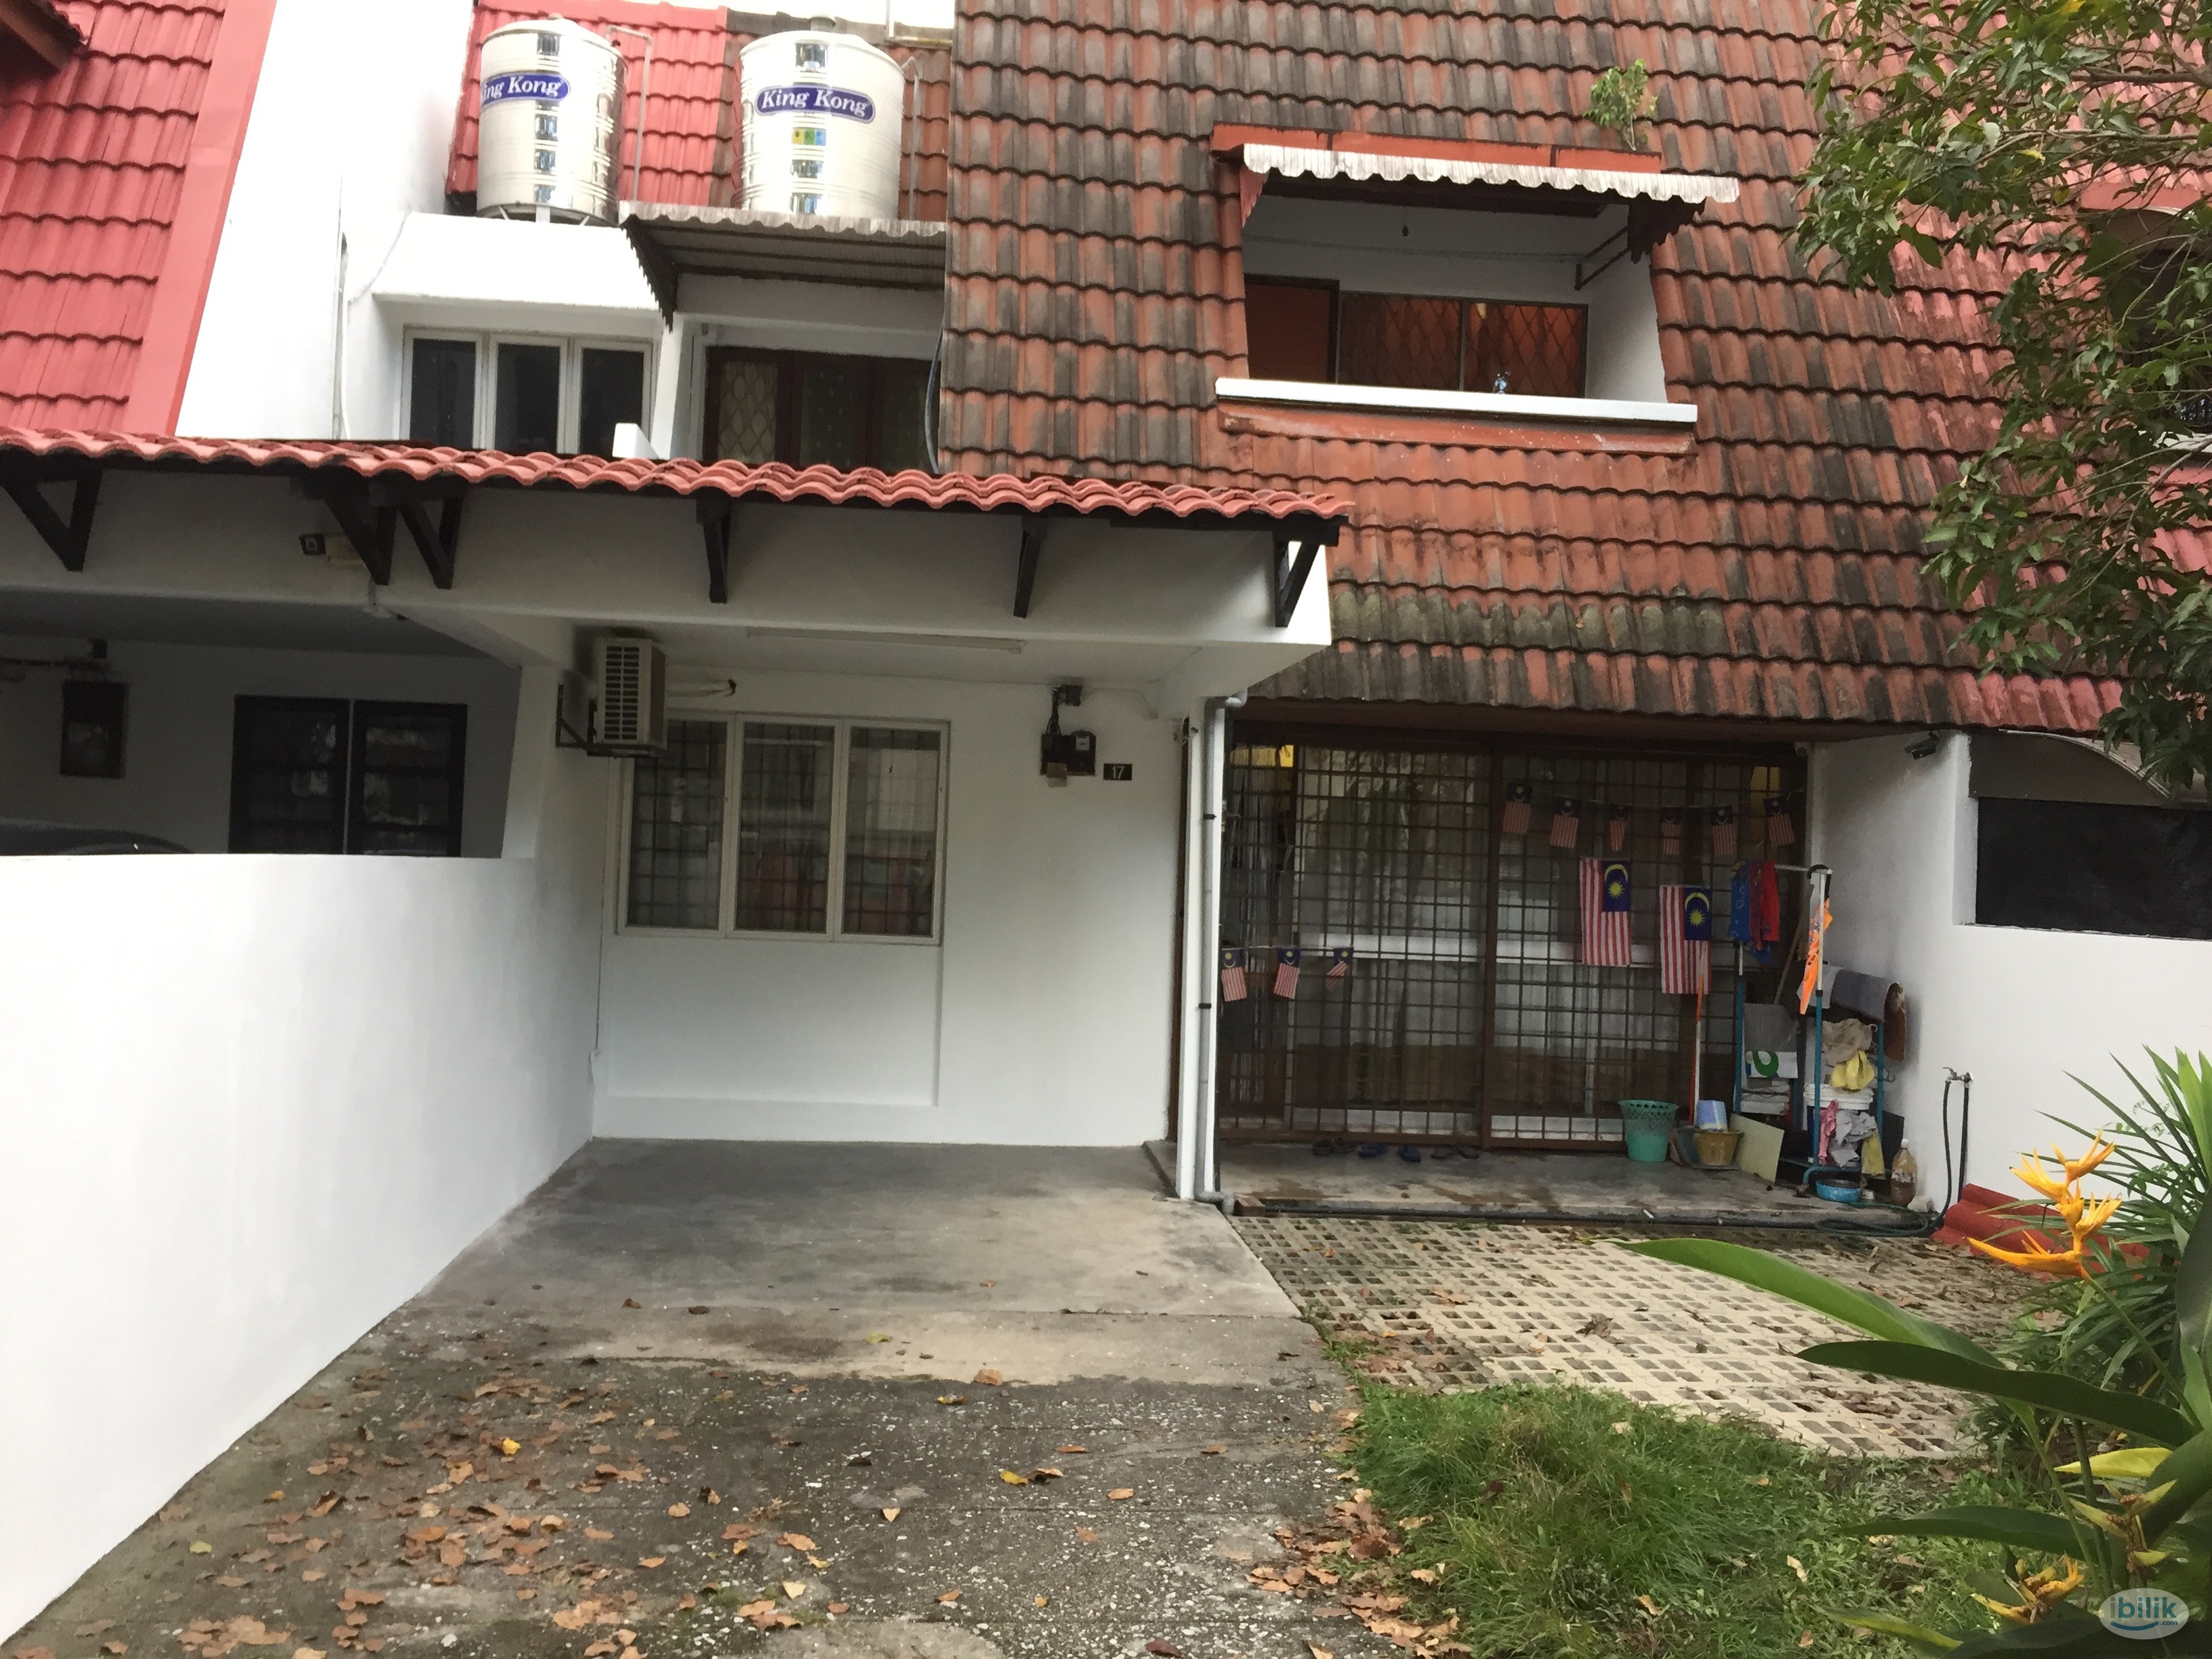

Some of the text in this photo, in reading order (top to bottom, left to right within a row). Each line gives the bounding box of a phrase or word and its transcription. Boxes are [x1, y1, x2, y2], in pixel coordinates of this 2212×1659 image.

[481, 75, 562, 100] ing Kong
[761, 89, 867, 118] King Kong
[1111, 765, 1126, 779] 17
